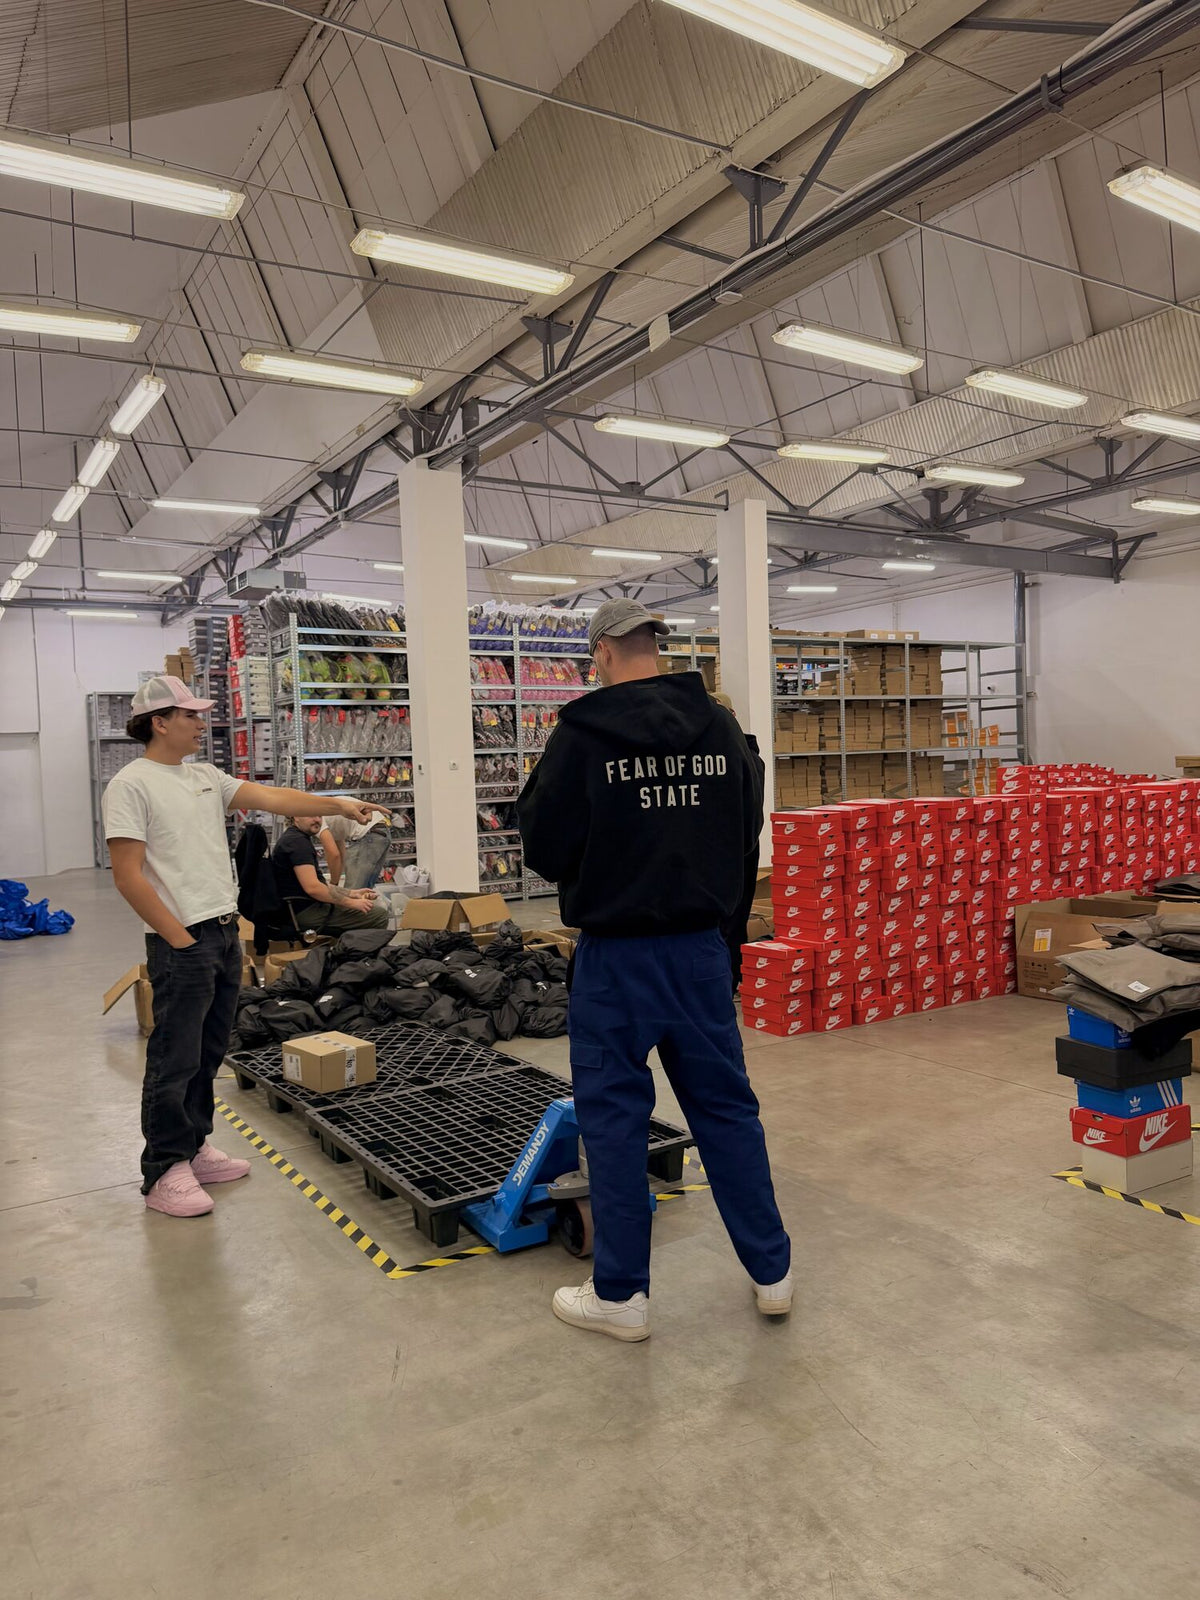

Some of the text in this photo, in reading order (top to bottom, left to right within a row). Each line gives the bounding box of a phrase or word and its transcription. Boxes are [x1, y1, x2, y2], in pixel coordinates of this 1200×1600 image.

[605, 754, 727, 784] FEAR OF GOD
[640, 784, 700, 809] STATE
[1087, 1127, 1106, 1140] NIKE
[1144, 1112, 1168, 1136] NIKE
[512, 1121, 549, 1186] DEMANDY
